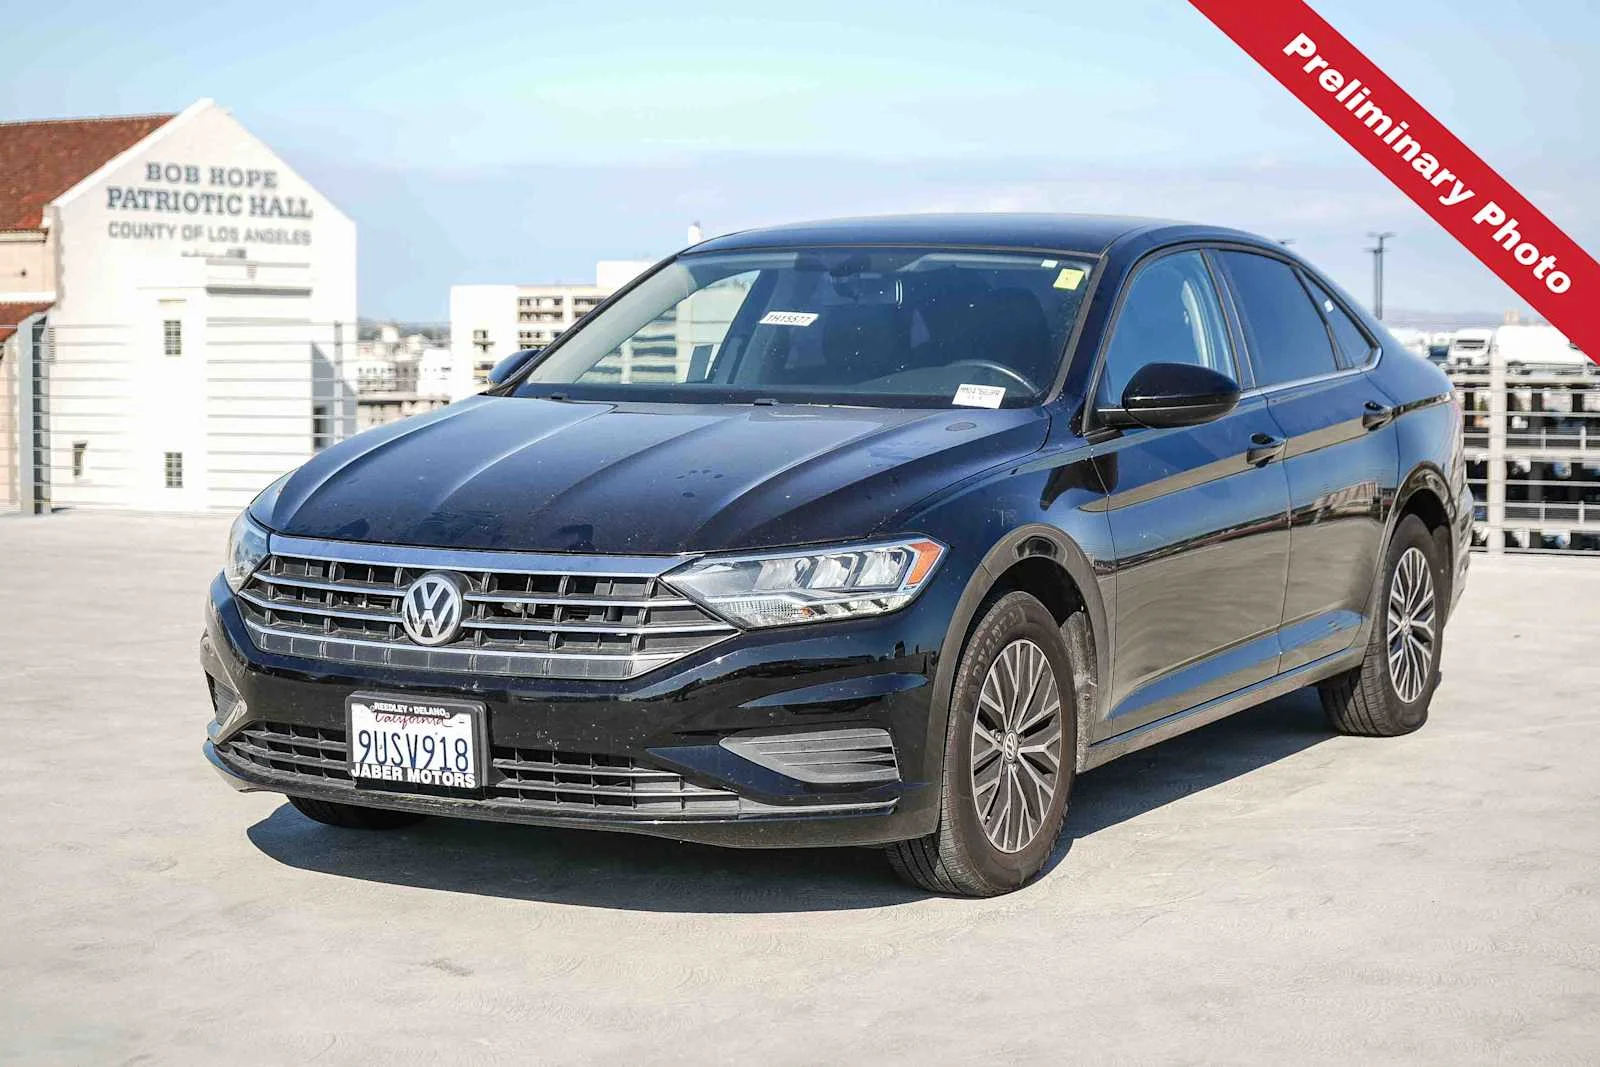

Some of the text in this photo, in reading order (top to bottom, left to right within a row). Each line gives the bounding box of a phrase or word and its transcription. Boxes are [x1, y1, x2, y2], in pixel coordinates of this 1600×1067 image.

[145, 162, 278, 189] BOB HOPE
[106, 187, 314, 220] PATRIOTIC HALL
[107, 221, 312, 246] COUNTY OF LOS ANGELES
[413, 706, 446, 716] DELANO
[358, 729, 469, 772] 9USV918
[351, 762, 476, 789] JABER MOTORS
